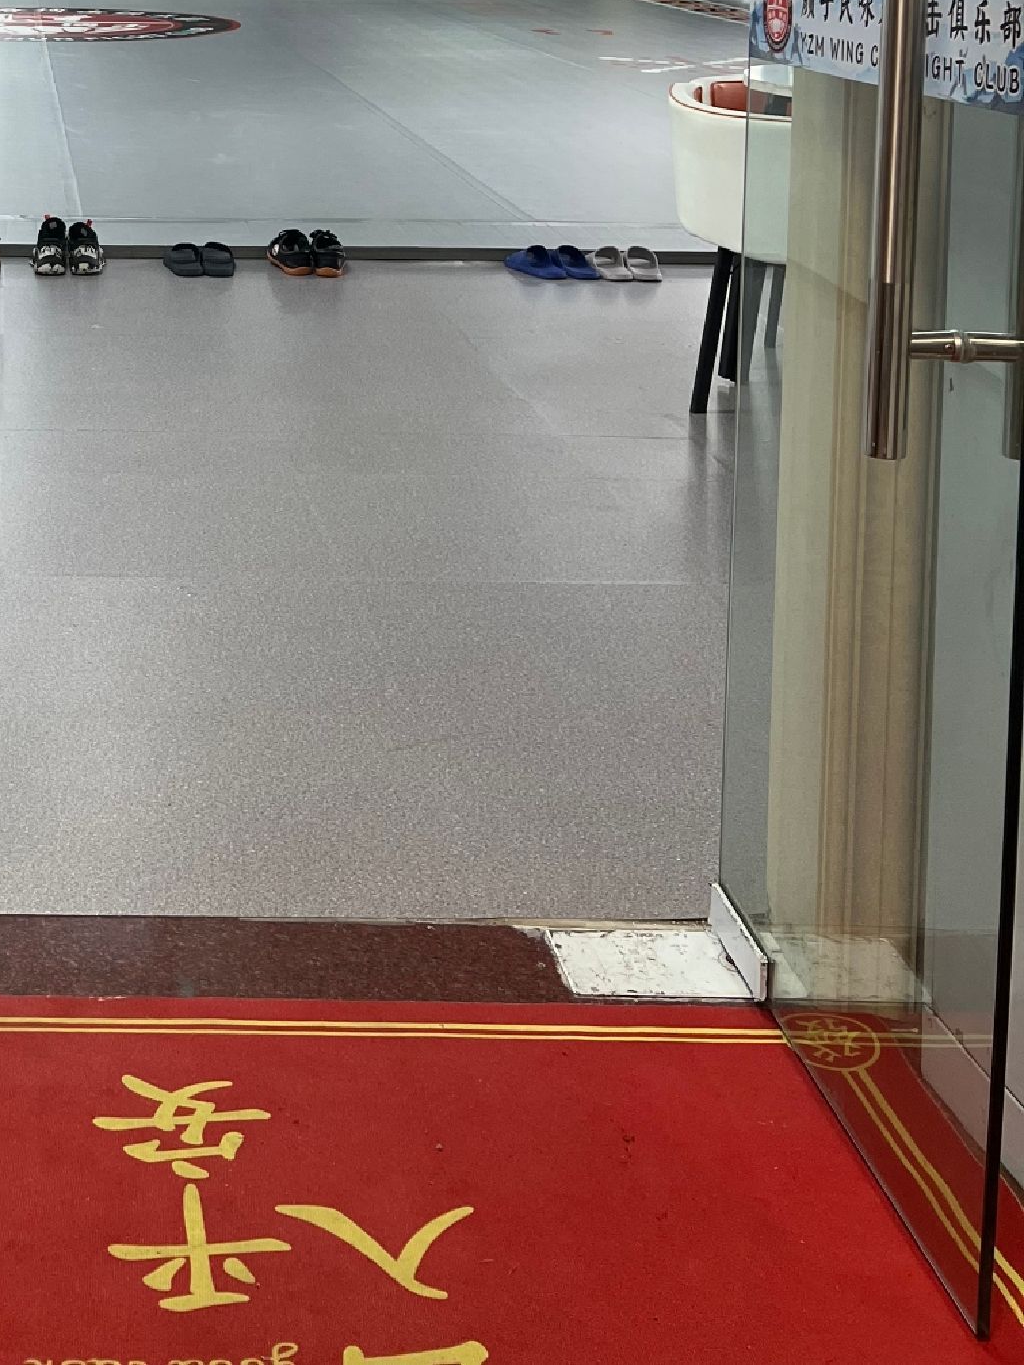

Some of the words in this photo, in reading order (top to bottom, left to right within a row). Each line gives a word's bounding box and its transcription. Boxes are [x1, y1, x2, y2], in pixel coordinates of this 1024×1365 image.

[830, 37, 864, 65] WING
[924, 54, 965, 87] IGHT
[973, 61, 1020, 94] CLUB
